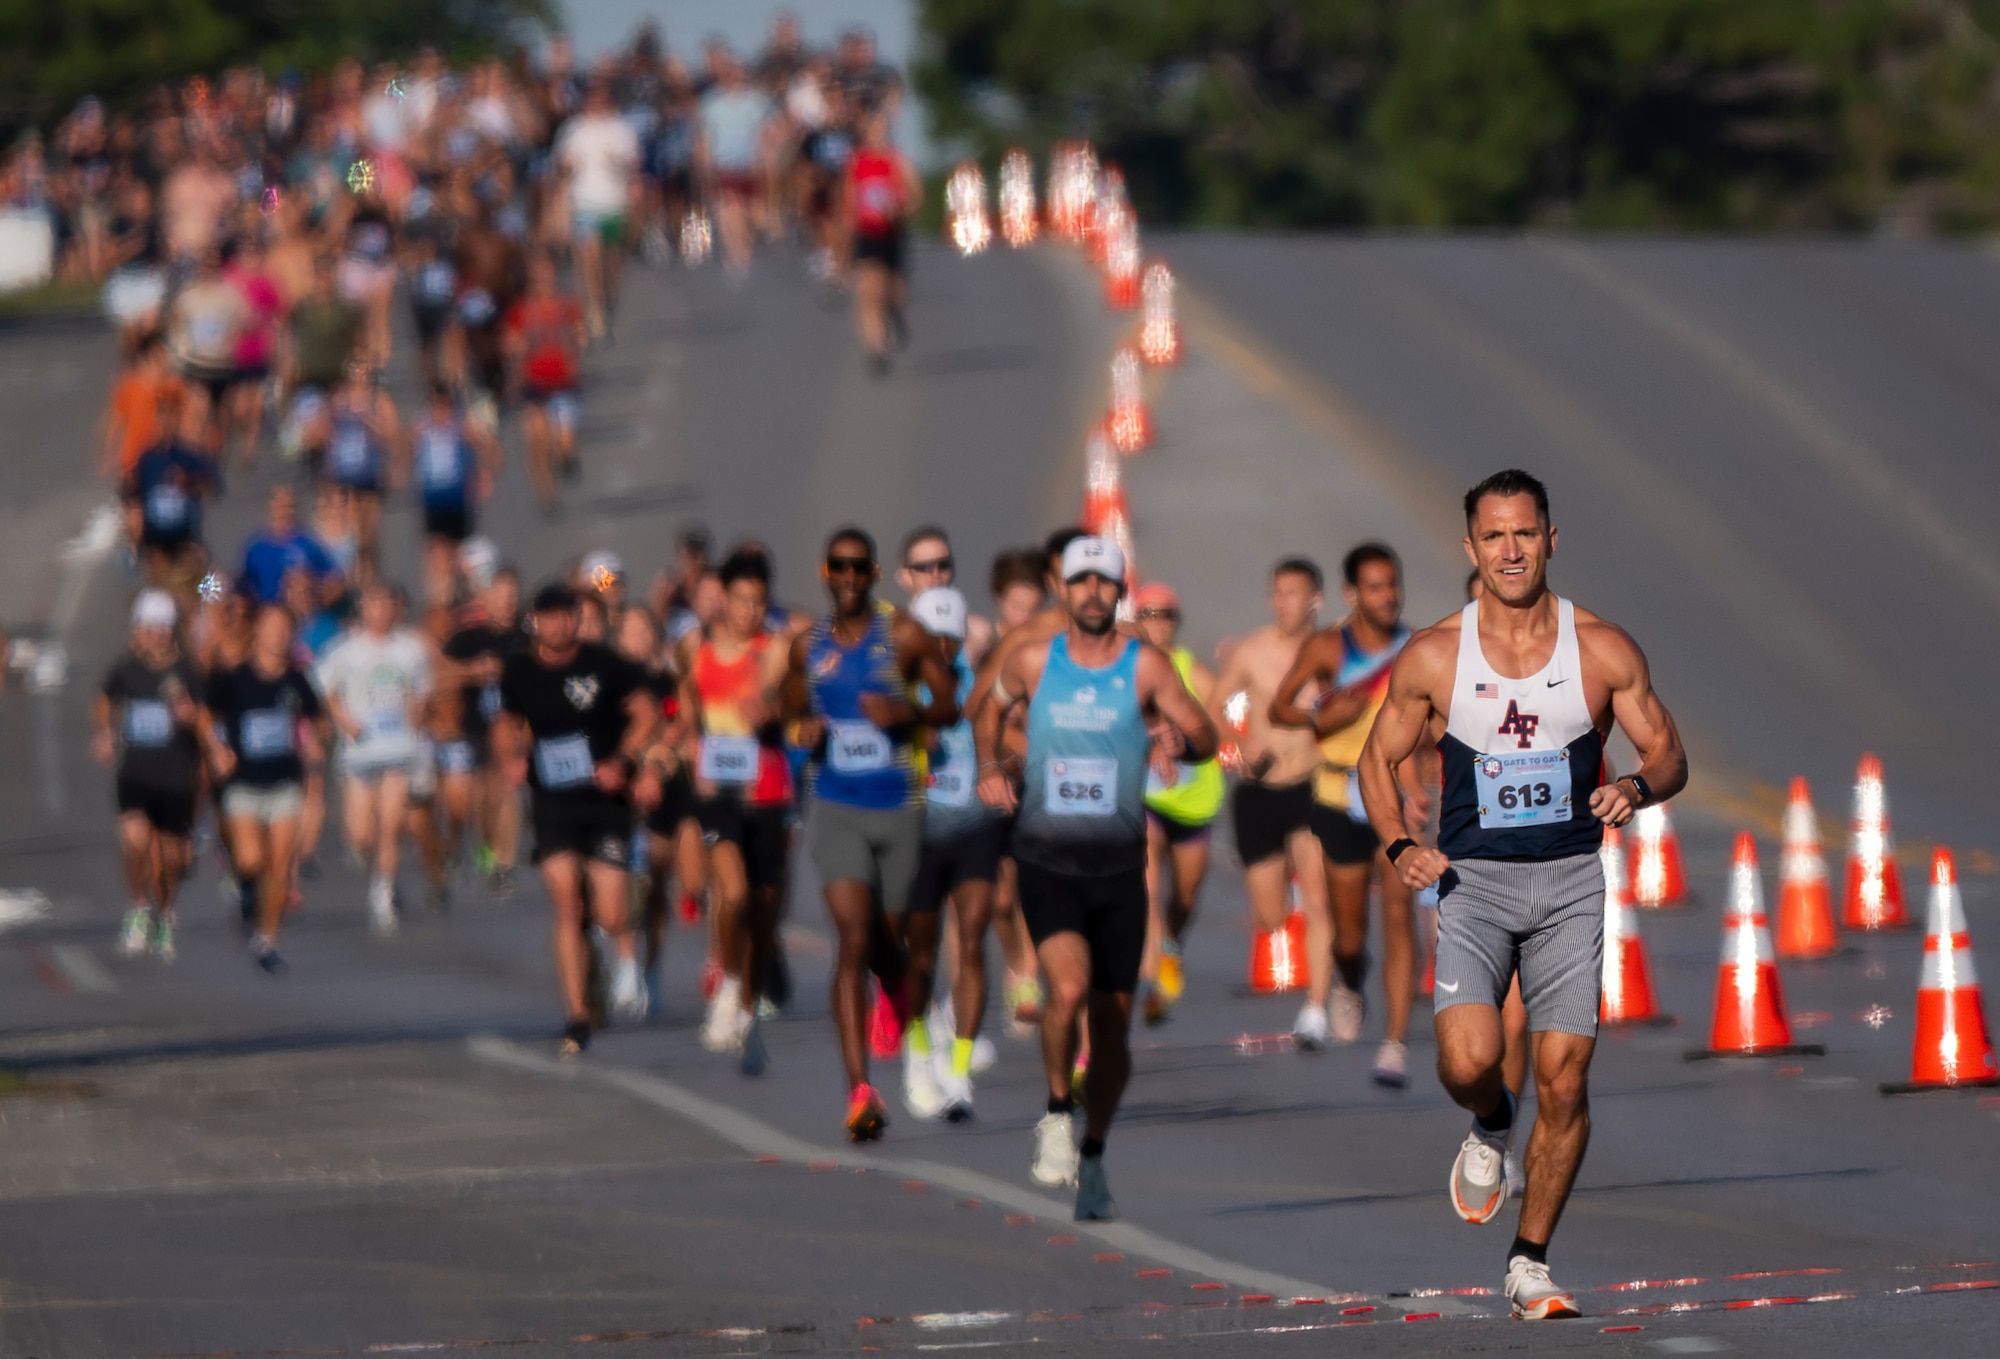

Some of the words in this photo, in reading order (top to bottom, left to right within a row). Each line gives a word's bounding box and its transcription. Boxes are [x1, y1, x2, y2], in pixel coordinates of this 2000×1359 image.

[1498, 699, 1539, 749] AF
[1503, 758, 1526, 767] GATE
[1529, 757, 1541, 765] TO
[1058, 781, 1104, 801] 626
[1498, 782, 1552, 809] 613
